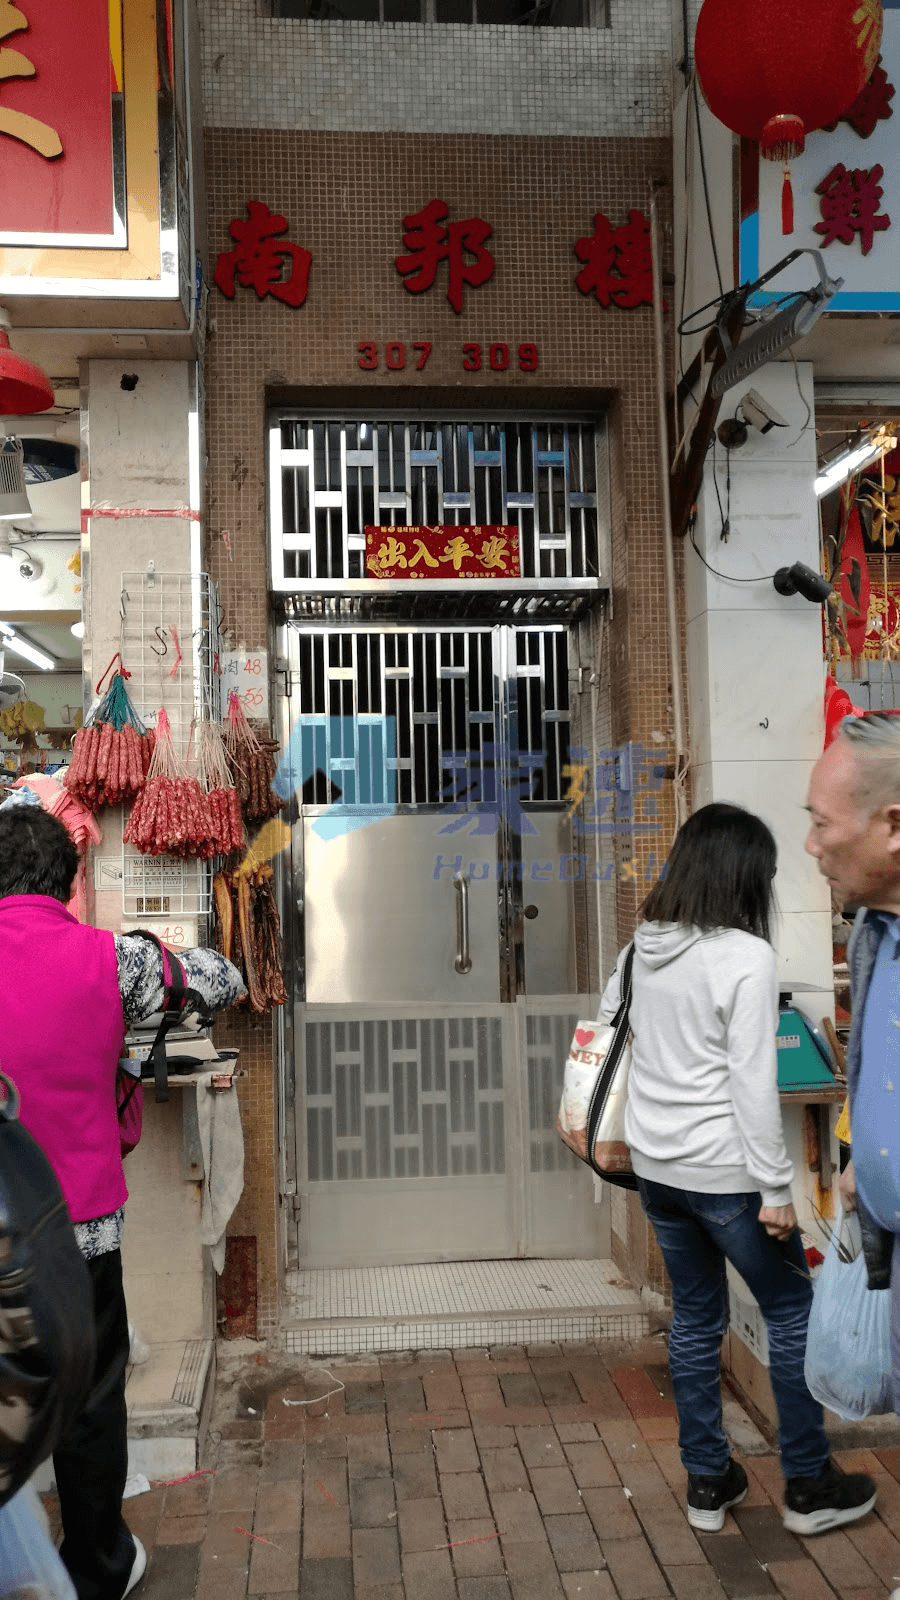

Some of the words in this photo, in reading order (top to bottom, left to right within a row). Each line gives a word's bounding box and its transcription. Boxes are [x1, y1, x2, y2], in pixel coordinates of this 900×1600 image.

[358, 341, 432, 370] 307
[462, 342, 539, 371] 309
[377, 535, 511, 571] 出入平安
[243, 658, 262, 675] 48
[160, 926, 185, 944] 48
